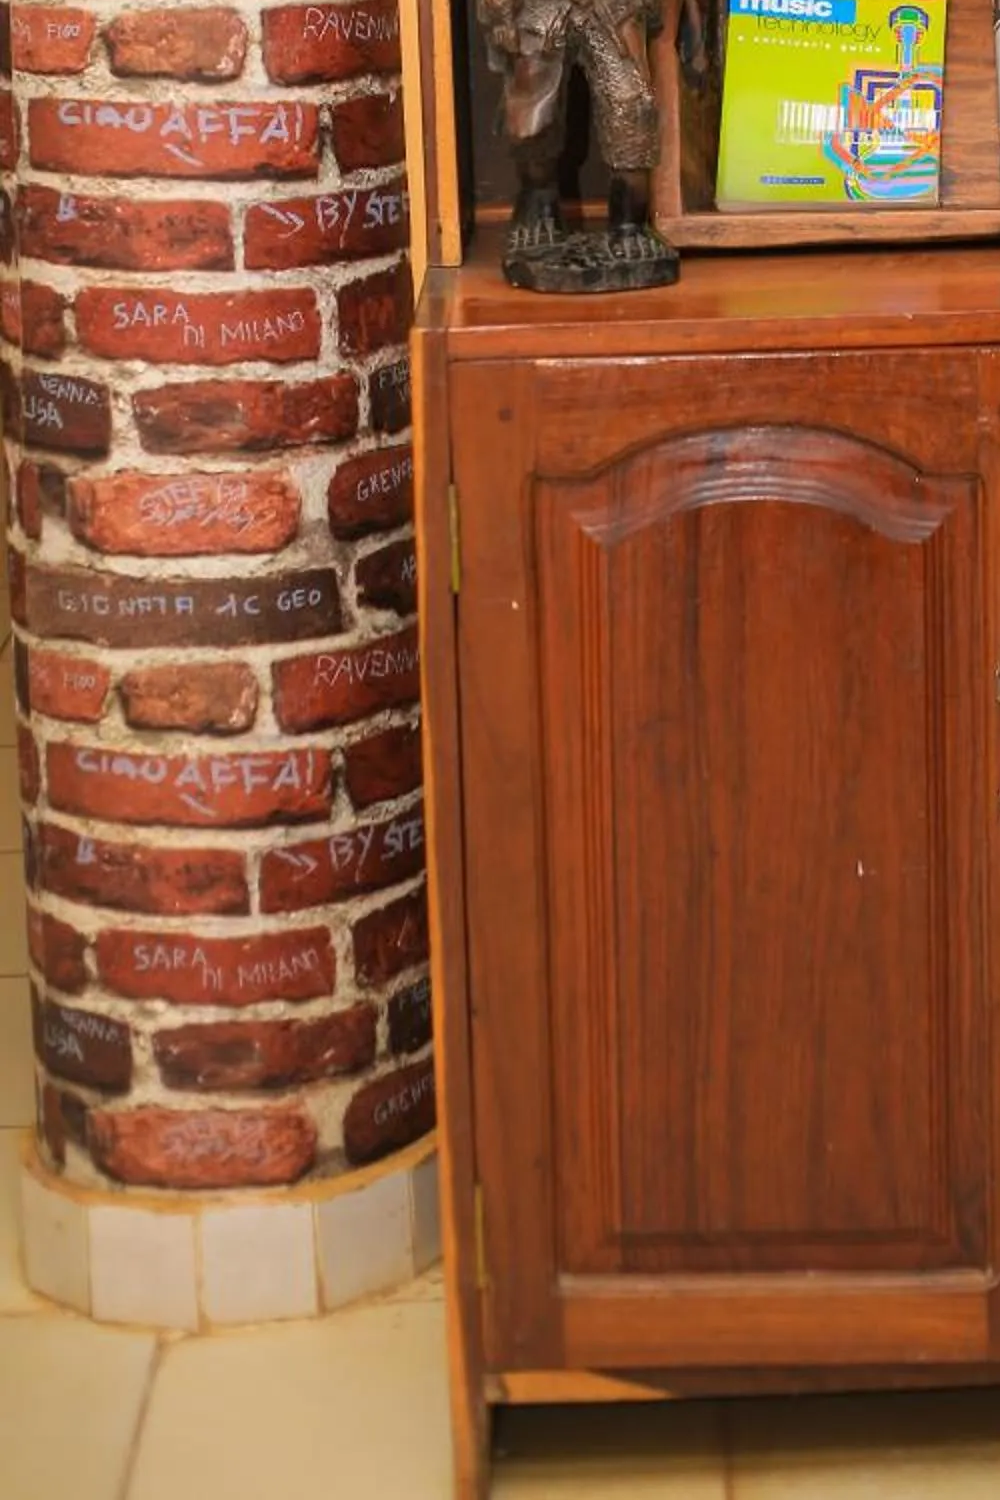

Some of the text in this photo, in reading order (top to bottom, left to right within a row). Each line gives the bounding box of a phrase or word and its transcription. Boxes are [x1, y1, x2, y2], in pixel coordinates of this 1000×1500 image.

[756, 14, 881, 42] Technology
[113, 301, 190, 329] SARA
[134, 945, 207, 972] SARA
